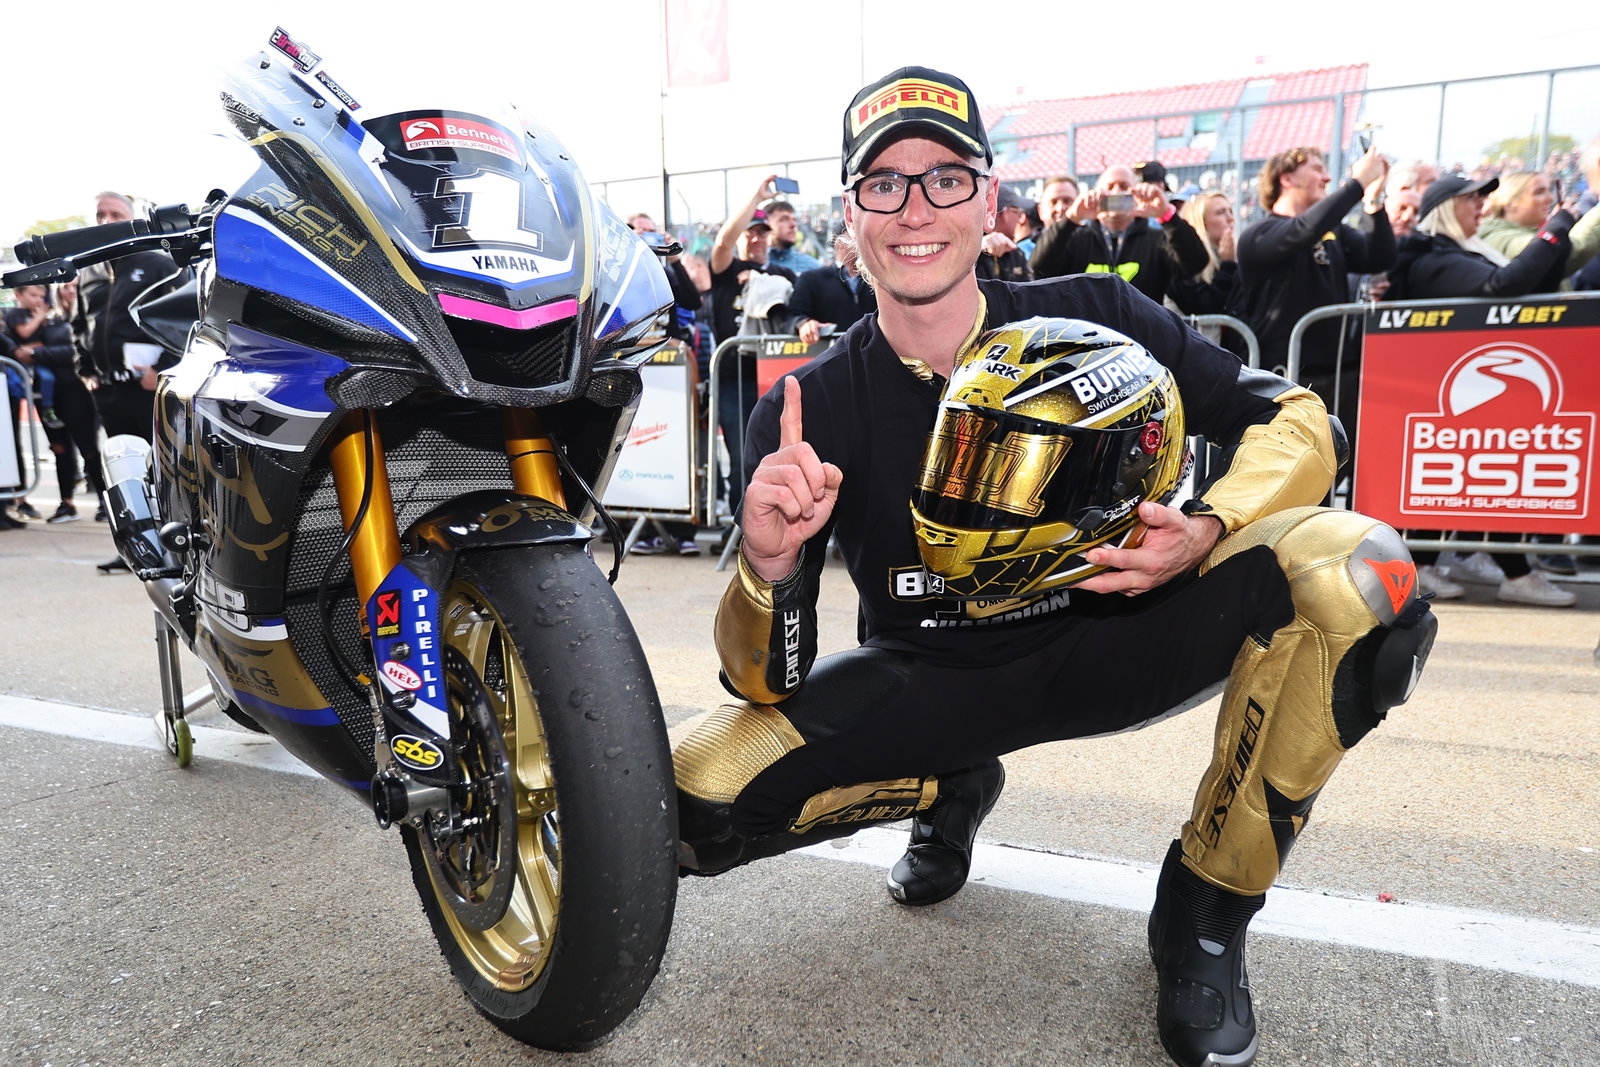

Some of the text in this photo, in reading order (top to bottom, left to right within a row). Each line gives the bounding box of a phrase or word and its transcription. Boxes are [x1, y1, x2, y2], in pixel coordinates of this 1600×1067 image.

[858, 83, 959, 126] PIRELLI
[409, 139, 456, 149] BRITISH
[256, 183, 367, 257] RICH
[434, 168, 543, 252] 1
[247, 193, 353, 262] ENERGY
[472, 255, 540, 274] YAMAHA
[1379, 305, 1568, 328] LVBET LVBET
[766, 341, 809, 356] LVBET
[1088, 382, 1141, 414] SWITCHGEAR
[1413, 422, 1583, 450] Bennetts
[1410, 453, 1580, 497] BSB
[1409, 495, 1577, 510] BRITISH SUPERBIKES
[412, 588, 438, 698] PIRELLI
[784, 609, 800, 689] DAINESE
[388, 667, 416, 686] HEL
[393, 740, 441, 765] sbs
[1206, 696, 1265, 849] DAINESE
